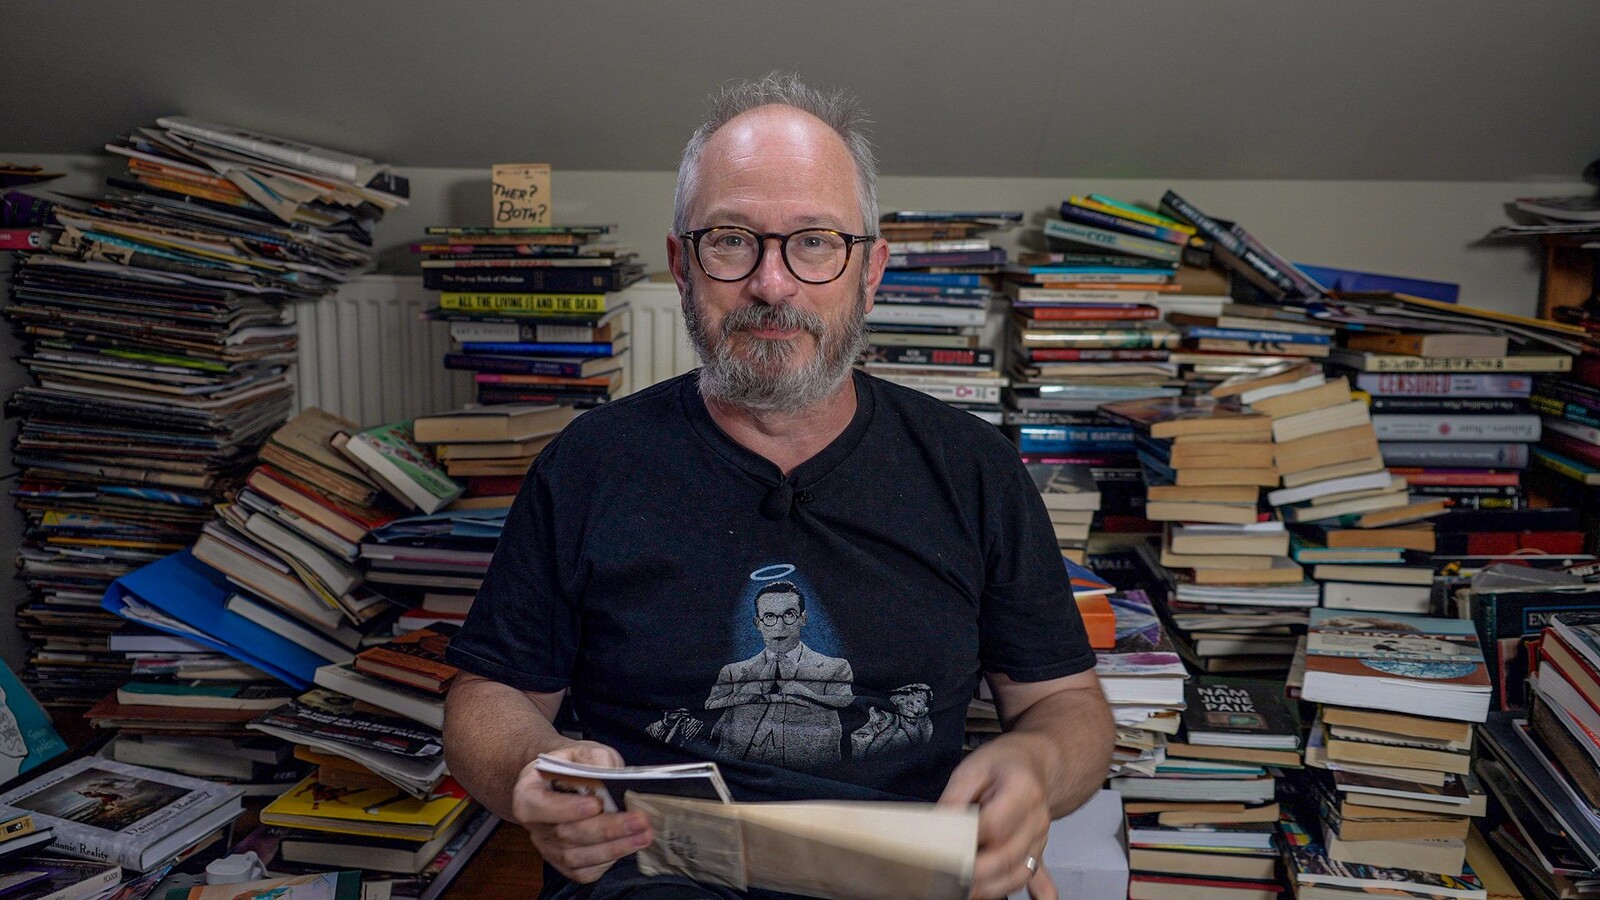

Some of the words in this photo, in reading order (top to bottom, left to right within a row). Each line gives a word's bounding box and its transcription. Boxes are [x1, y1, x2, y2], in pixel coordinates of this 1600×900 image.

[458, 296, 473, 307] ALL
[476, 296, 491, 307] THE
[495, 297, 522, 308] LIVING
[536, 298, 551, 309] AND
[556, 298, 571, 309] THE
[575, 299, 598, 310] DEAD
[1378, 373, 1451, 394] CENSORED
[1069, 430, 1088, 441] THE
[1197, 687, 1249, 697] NAM
[1201, 695, 1253, 705] JUNE
[1205, 703, 1256, 713] PAIK
[172, 791, 210, 815] Reality
[80, 843, 109, 861] Reality
[103, 871, 119, 884] PICADOR
